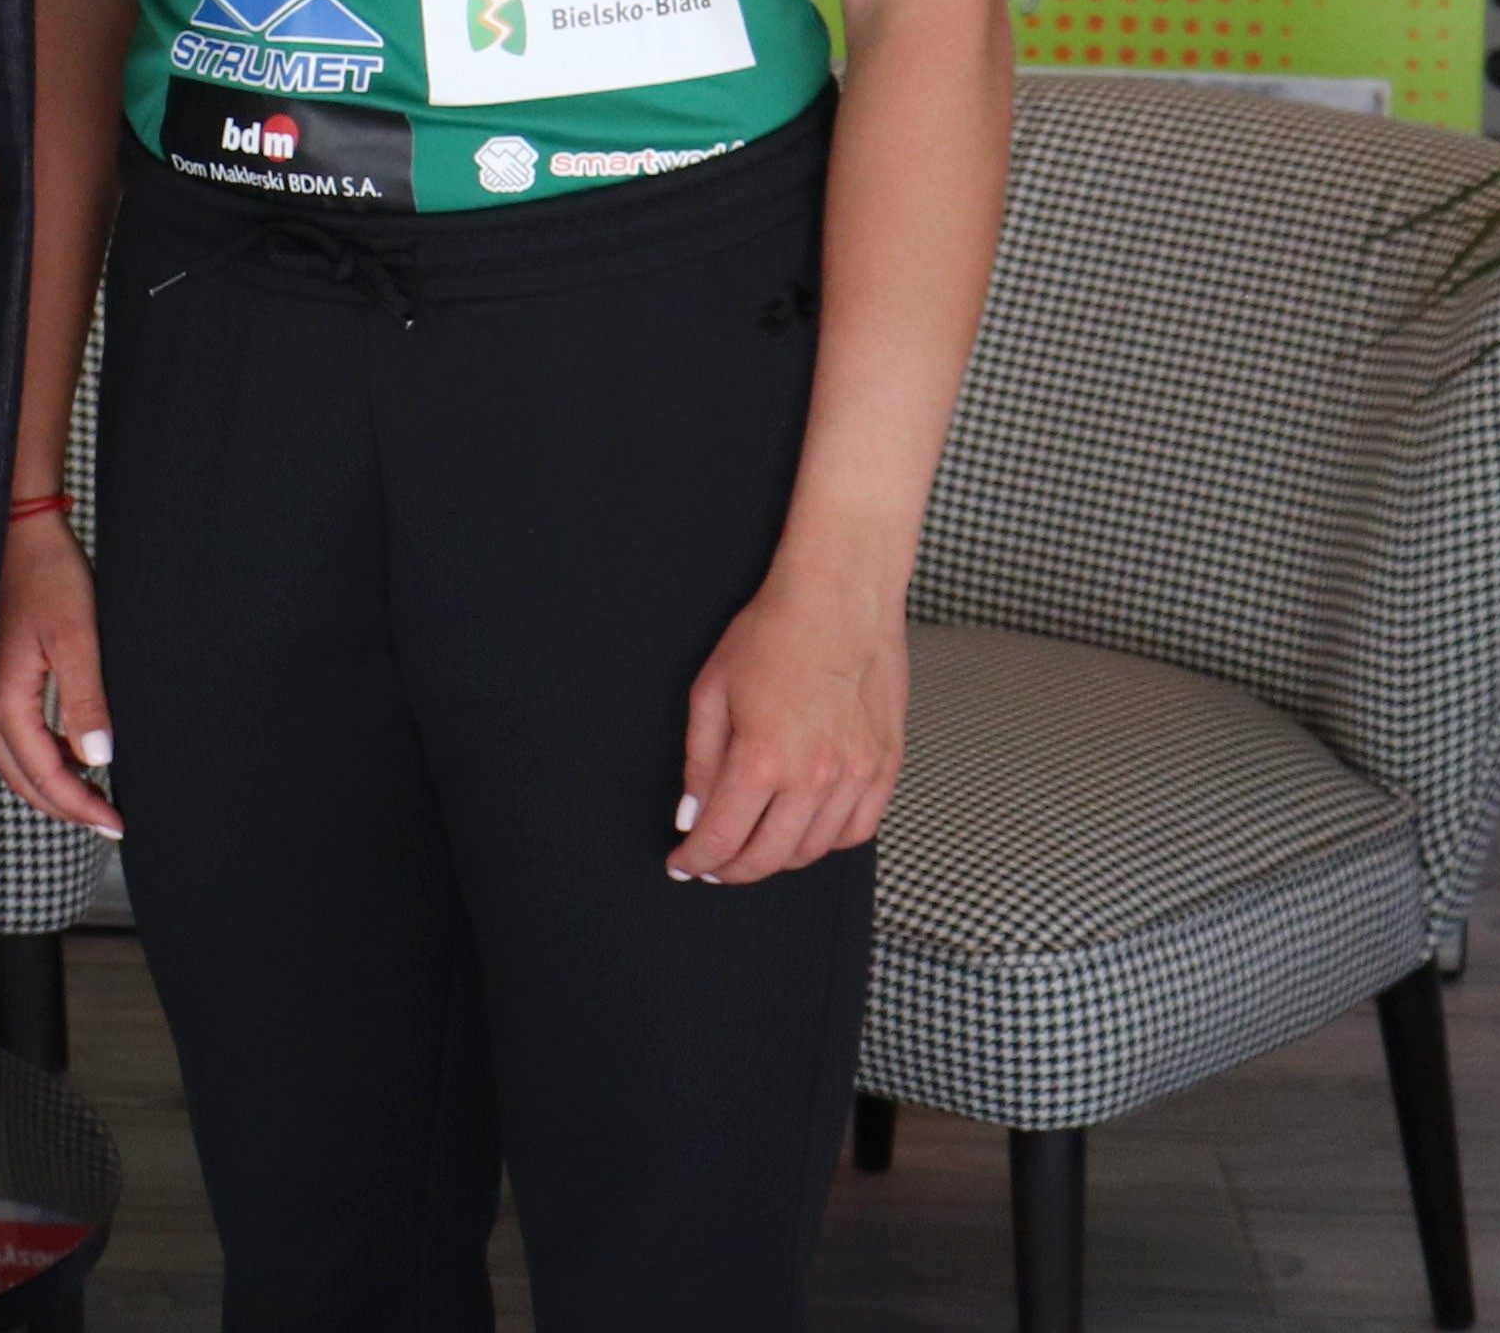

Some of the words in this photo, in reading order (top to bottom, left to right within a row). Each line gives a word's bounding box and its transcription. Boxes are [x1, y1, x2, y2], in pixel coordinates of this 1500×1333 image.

[172, 30, 384, 93] STRUMET
[222, 117, 295, 160] bdm
[171, 153, 207, 179] Dom
[209, 163, 285, 194] Maklerski
[289, 175, 338, 197] BDM
[342, 177, 382, 199] S.A.
